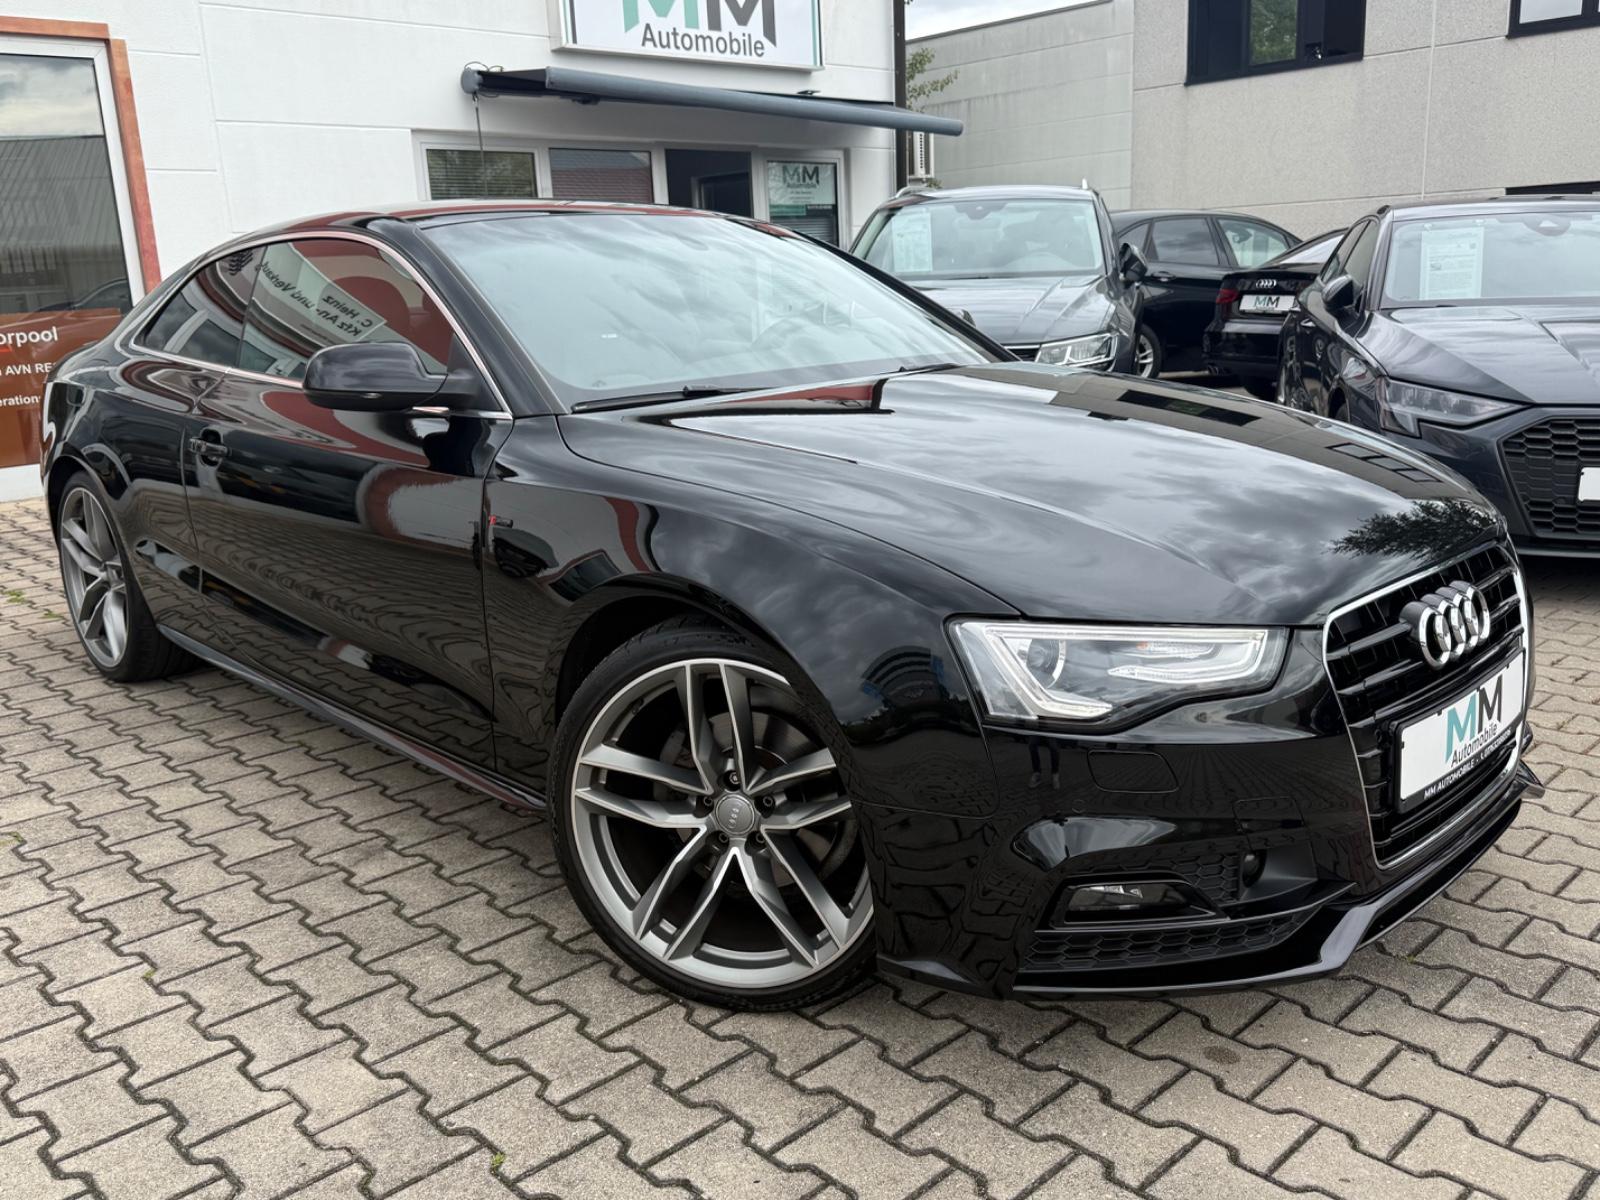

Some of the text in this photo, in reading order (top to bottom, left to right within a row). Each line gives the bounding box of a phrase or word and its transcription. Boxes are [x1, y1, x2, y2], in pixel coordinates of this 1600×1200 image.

[641, 23, 765, 57] Automobile
[782, 165, 819, 184] MM
[1254, 296, 1280, 308] MM
[5, 363, 32, 376] AVN
[35, 362, 57, 375] RE
[1445, 674, 1503, 763] MM
[1451, 722, 1498, 768] Automobile
[1424, 759, 1475, 799] MM AUTOMOBILE
